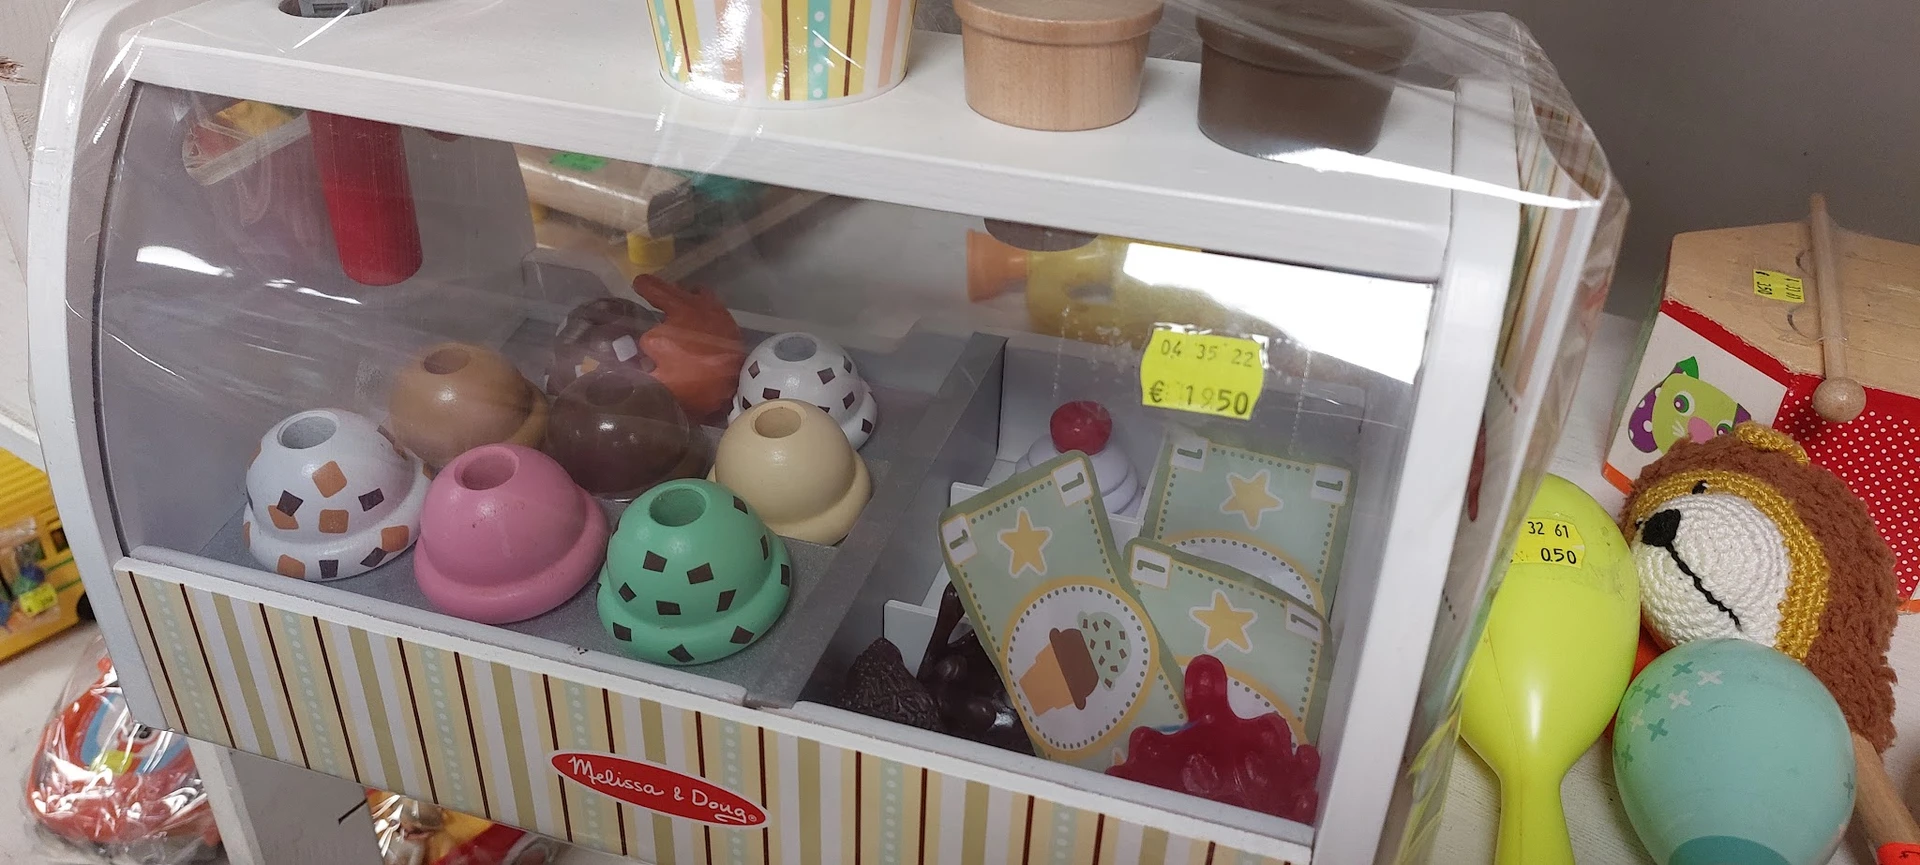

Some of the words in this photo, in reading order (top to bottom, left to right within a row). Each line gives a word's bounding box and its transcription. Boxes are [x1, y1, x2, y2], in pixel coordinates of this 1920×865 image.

[1161, 339, 1182, 359] 04
[1195, 344, 1218, 361] 35
[1231, 348, 1254, 367] 22
[1149, 380, 1165, 403] €
[1527, 521, 1545, 535] 32
[1554, 523, 1569, 538] 61
[567, 759, 664, 796] Melissa
[673, 786, 685, 801] &
[691, 788, 746, 824] Doug
